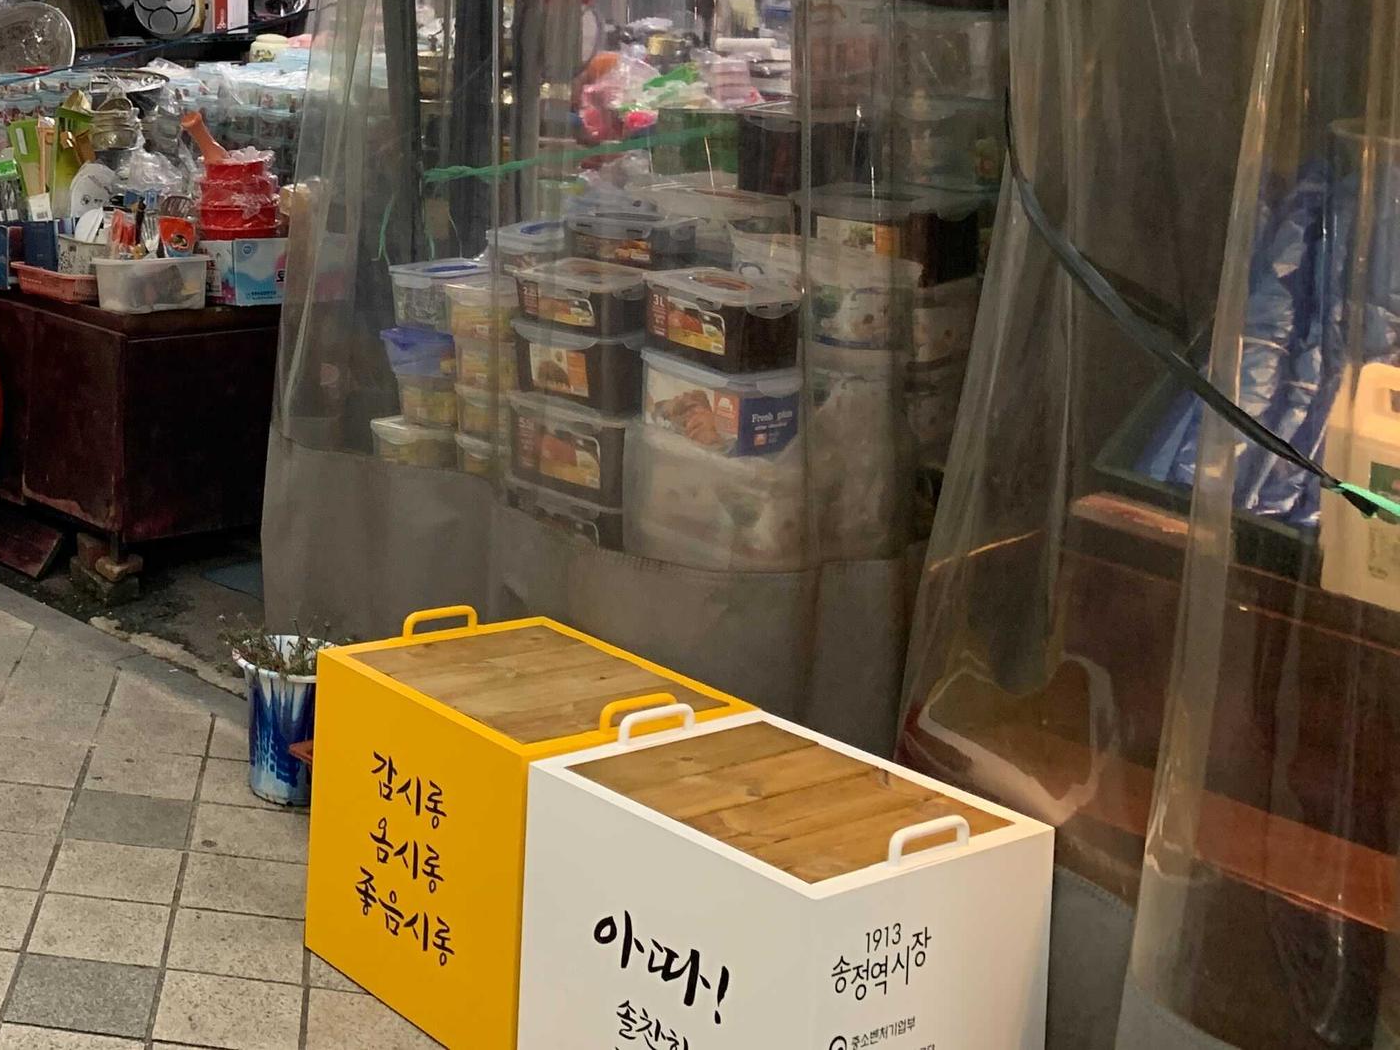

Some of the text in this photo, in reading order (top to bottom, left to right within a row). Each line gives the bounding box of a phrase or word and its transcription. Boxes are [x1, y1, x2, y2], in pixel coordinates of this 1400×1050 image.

[371, 751, 448, 829] 감시롱
[369, 817, 445, 894] 옴시롱
[355, 866, 455, 967] 좋음시롱
[864, 922, 902, 954] 1913
[593, 909, 731, 1025] 아따!
[831, 926, 933, 1001] 송정역시장
[851, 1015, 916, 1050] 중소벤처기업부
